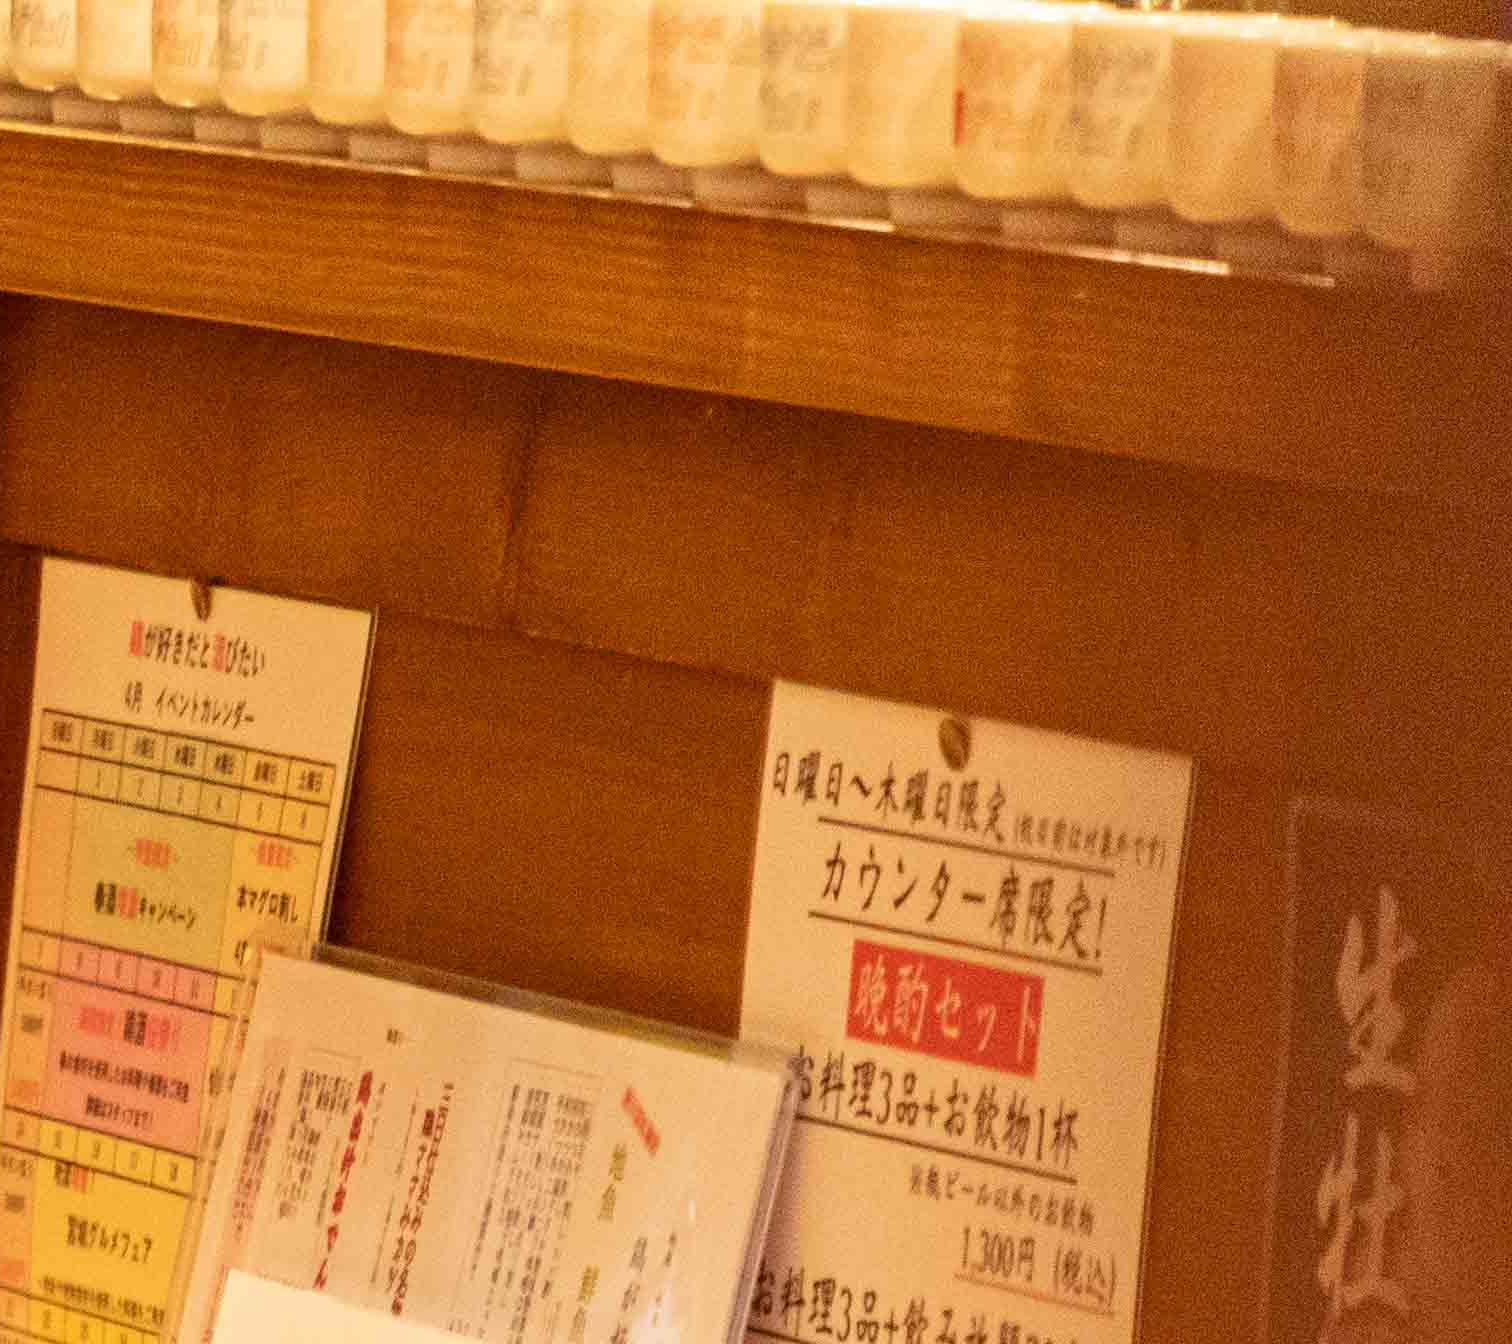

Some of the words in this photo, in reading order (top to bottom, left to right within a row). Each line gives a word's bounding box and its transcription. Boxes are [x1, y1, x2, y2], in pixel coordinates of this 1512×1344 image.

[853, 952, 1038, 1064] 晩酌セット
